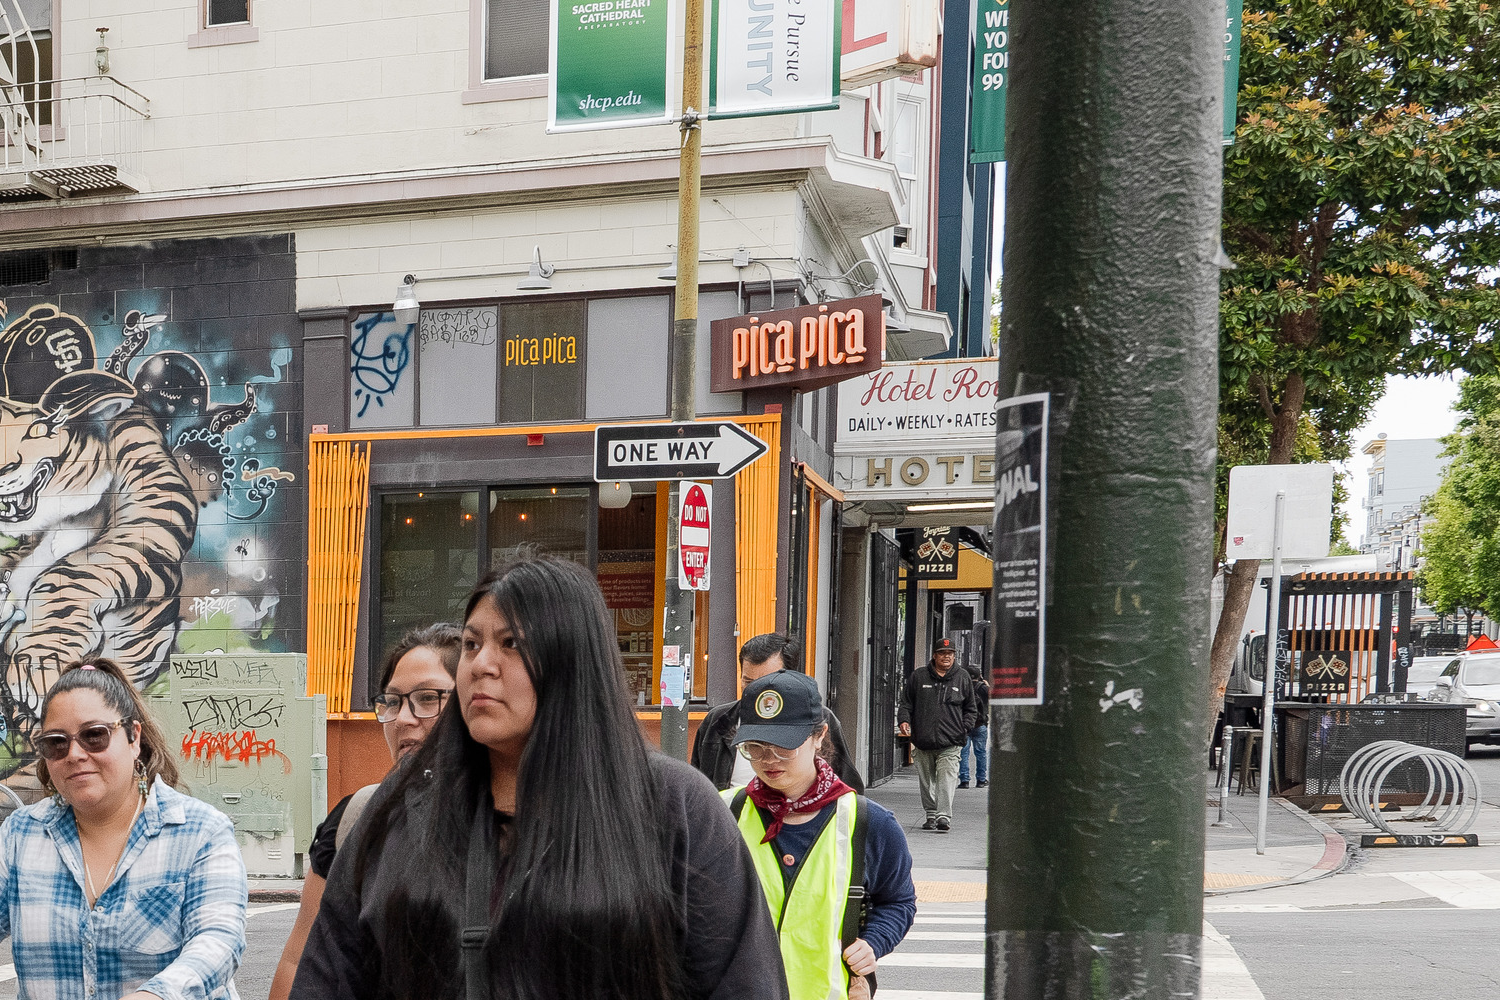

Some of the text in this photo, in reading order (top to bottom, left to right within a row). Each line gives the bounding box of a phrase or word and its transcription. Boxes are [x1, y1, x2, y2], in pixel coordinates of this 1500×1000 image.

[572, 0, 615, 15] SACRED
[579, 9, 644, 24] CATHEDRAL
[578, 20, 647, 31] PREPARATORY
[786, 12, 806, 82] Pursue
[578, 92, 642, 112] shcp.edu
[506, 335, 539, 366] pica
[543, 332, 577, 365] pica
[732, 304, 867, 380] pica pica
[860, 368, 938, 406] Hotel
[849, 412, 997, 433] DAILY WEEKLY RATES
[613, 441, 713, 463] ONE WAY
[684, 505, 707, 522] DO NOT
[685, 551, 704, 568] ENTER
[918, 563, 953, 573] PIZZA
[1307, 683, 1345, 691] PIZZA
